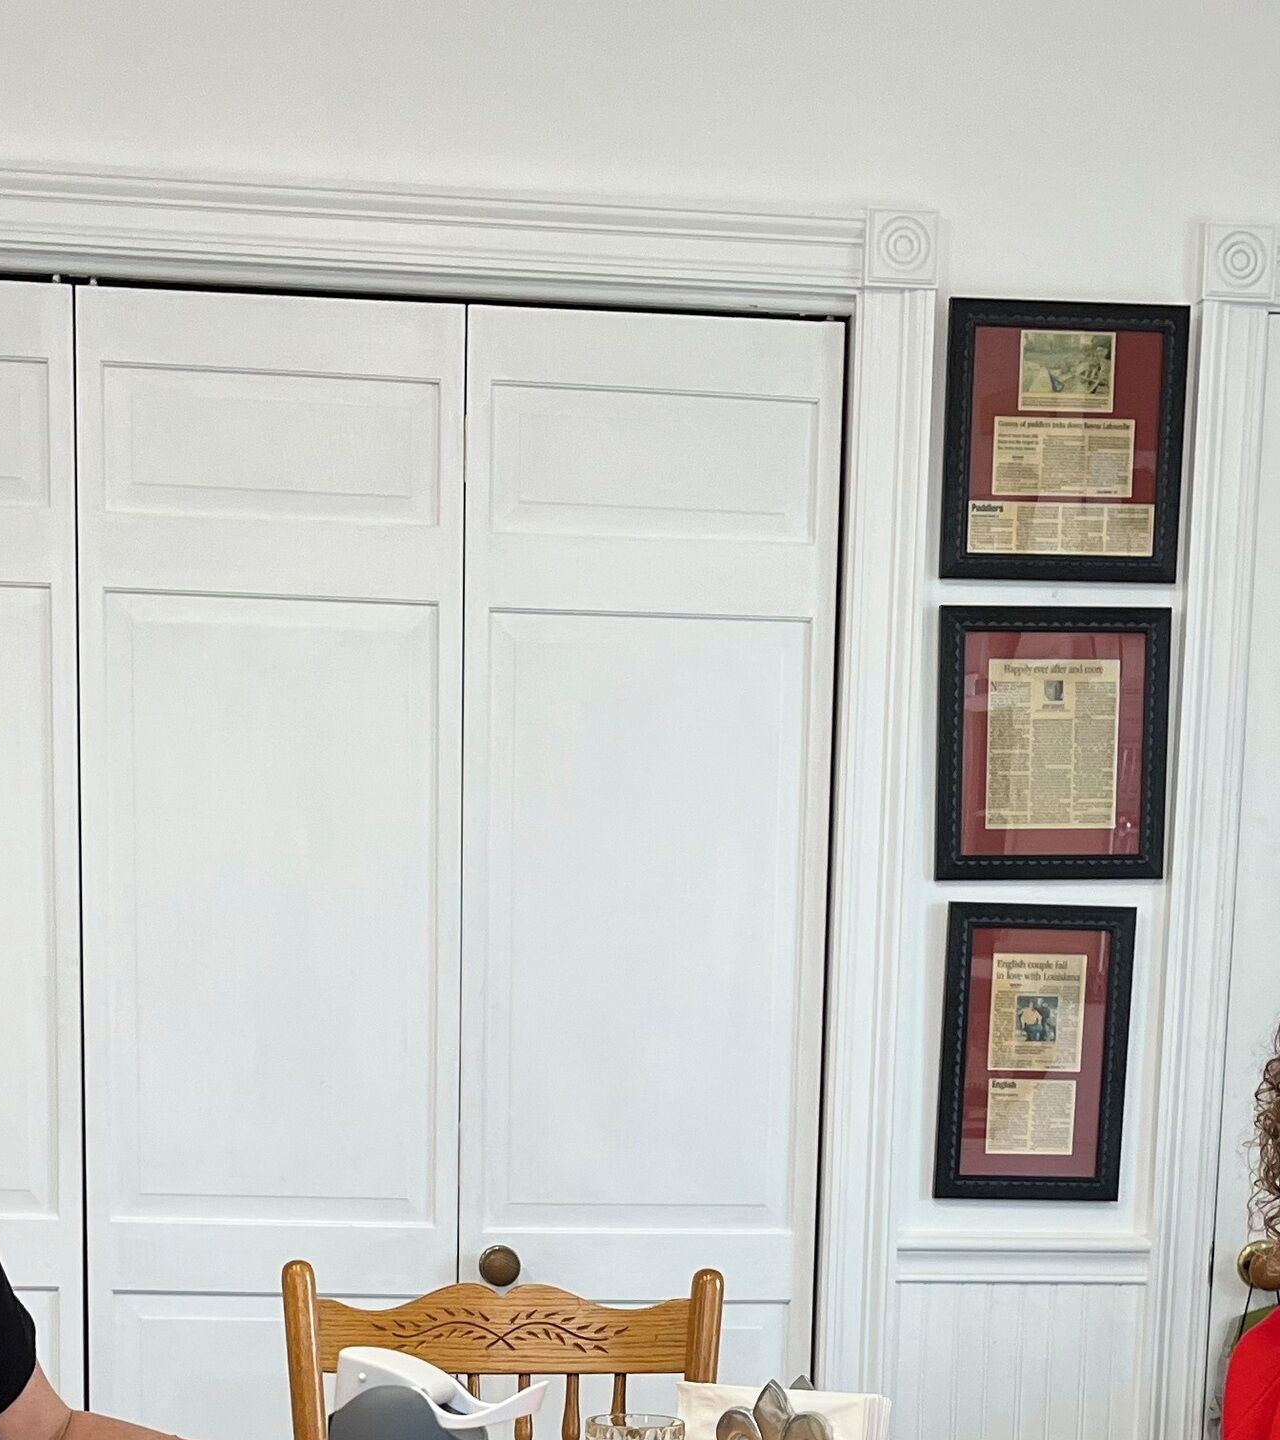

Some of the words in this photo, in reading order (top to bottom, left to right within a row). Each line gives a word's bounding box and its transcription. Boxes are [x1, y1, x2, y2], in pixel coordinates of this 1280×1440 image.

[1004, 664, 1032, 676] Happily
[1033, 666, 1048, 674] ever
[1050, 664, 1067, 674] after
[1068, 664, 1083, 673] and
[1084, 666, 1104, 674] more
[996, 959, 1026, 970] English
[1027, 960, 1054, 972] couple
[1055, 960, 1068, 969] fall
[1006, 971, 1022, 980] love
[1024, 972, 1041, 980] with
[991, 1080, 1016, 1090] English
